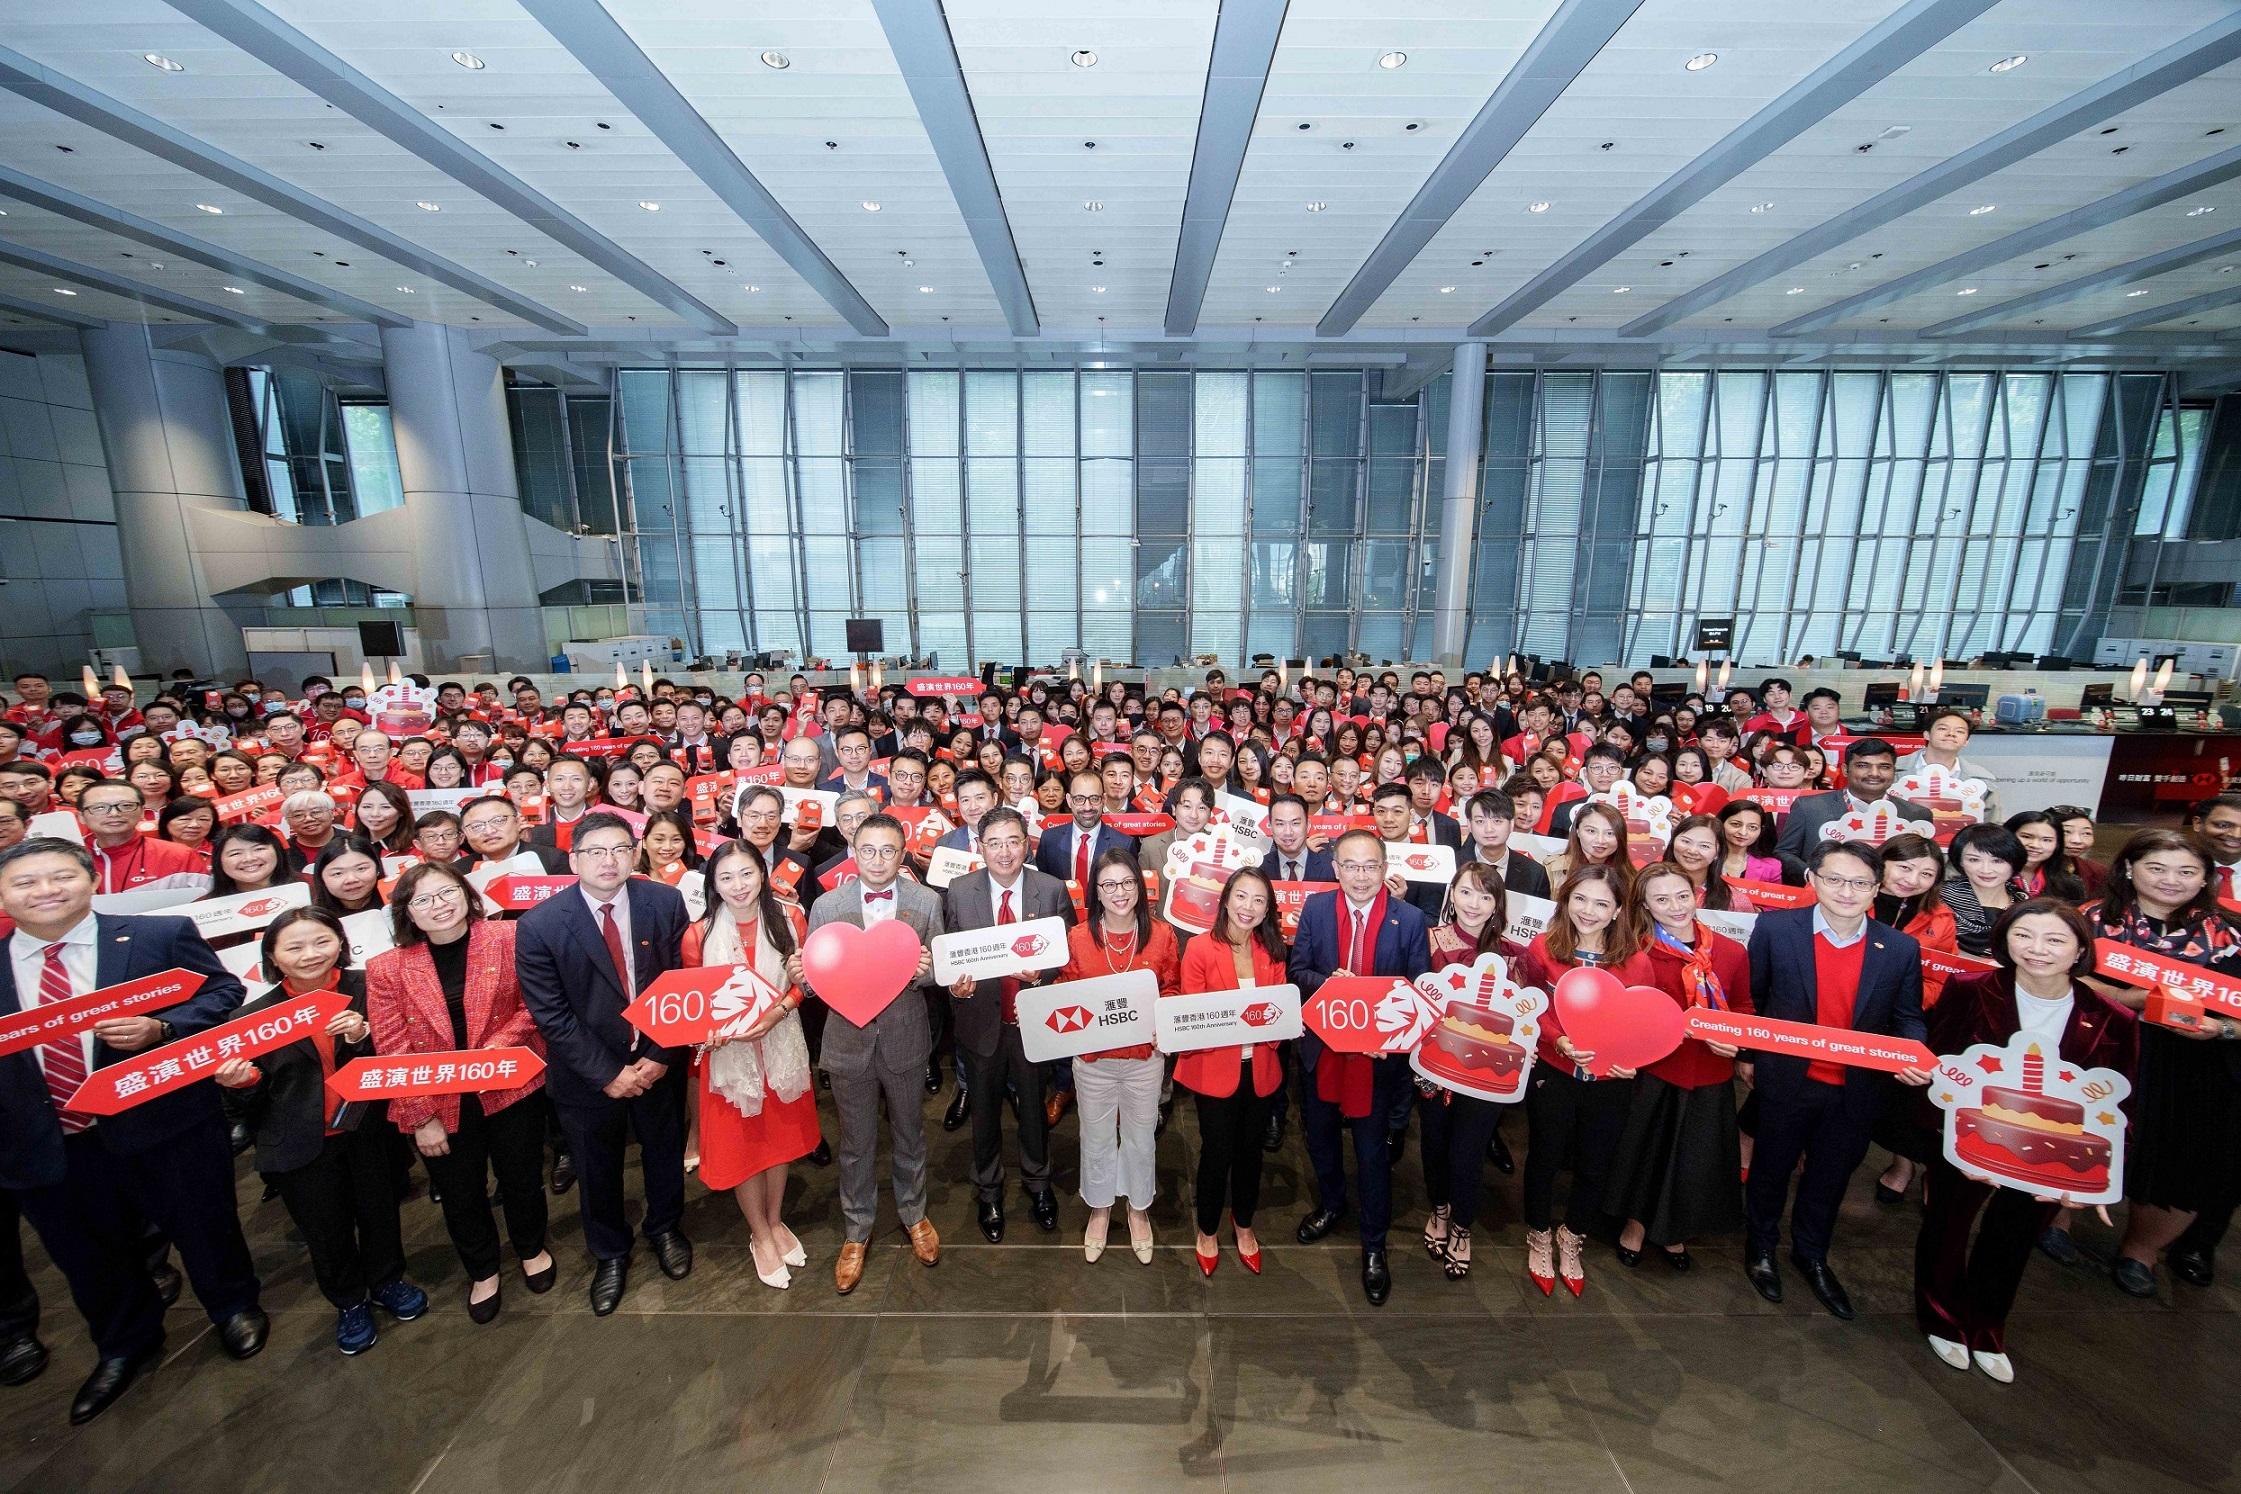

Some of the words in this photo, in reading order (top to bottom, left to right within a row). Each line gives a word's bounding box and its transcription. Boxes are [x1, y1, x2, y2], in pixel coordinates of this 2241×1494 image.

[916, 682, 975, 692] 盛演世界160年
[1705, 704, 1714, 713] 19
[1919, 706, 1929, 714] 21
[2141, 708, 2155, 716] 23
[2160, 708, 2173, 716] 24
[1114, 820, 1122, 828] of
[1123, 821, 1142, 829] great
[1313, 823, 1332, 831] years
[1231, 823, 1258, 839] HSBC
[1749, 887, 1760, 896] of
[1761, 890, 1785, 899] great
[243, 903, 264, 914] 160
[1015, 942, 1031, 952] 160
[980, 953, 1009, 963] Anniversary
[44, 1014, 65, 1029] of
[70, 1001, 119, 1023] great
[123, 983, 182, 1006] stories
[644, 989, 705, 1026] 160
[1104, 997, 1129, 1011] 滙豐
[1098, 1010, 1139, 1027] HSBC
[1245, 1011, 1262, 1021] 160
[1315, 999, 1369, 1030] 160
[1174, 1025, 1190, 1033] HSBC
[1206, 1021, 1237, 1029] Anniversary
[1690, 1017, 1742, 1037] Creating
[1746, 1027, 1770, 1040] 160
[1773, 1033, 1809, 1046] years
[1812, 1038, 1826, 1049] of
[1829, 1041, 1865, 1055] great
[1869, 1048, 1918, 1064] stories
[114, 1005, 321, 1099] 盛演世界160年
[359, 1059, 518, 1089] 盛演世界160年
